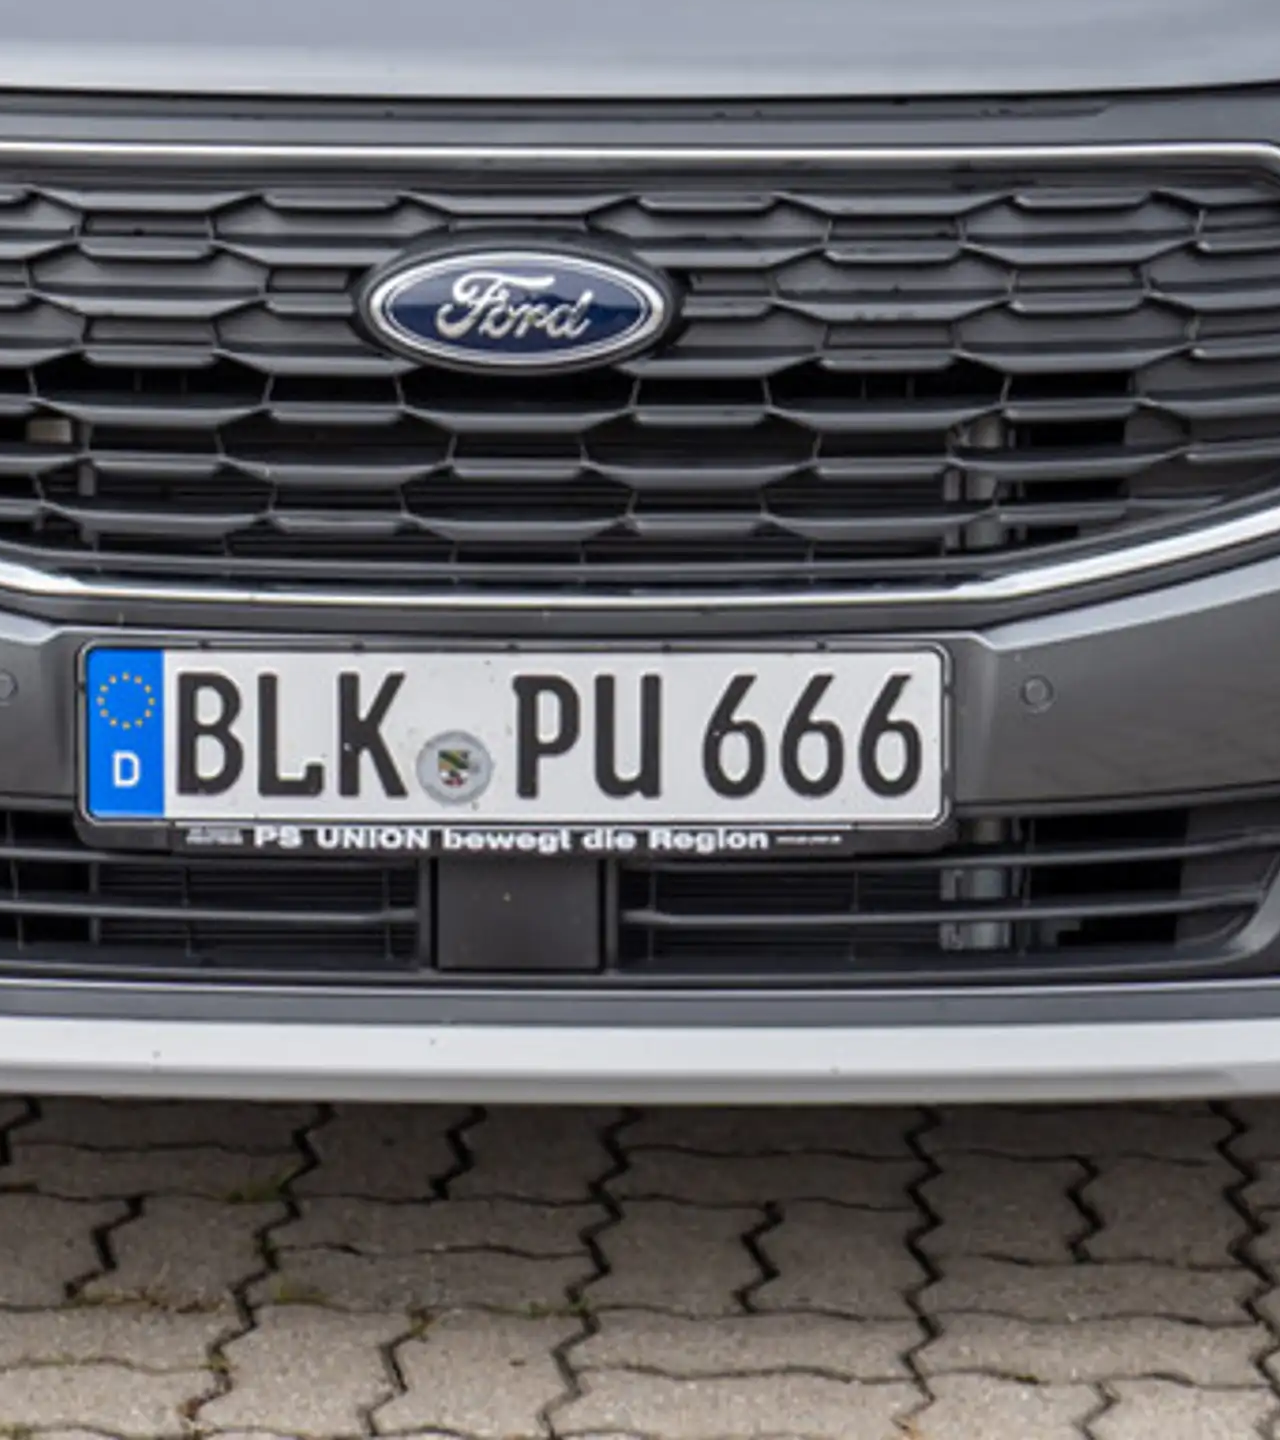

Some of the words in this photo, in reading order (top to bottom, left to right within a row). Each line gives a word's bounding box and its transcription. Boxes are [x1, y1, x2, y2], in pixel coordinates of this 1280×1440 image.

[435, 271, 595, 340] Ford
[176, 672, 409, 799] BLK
[512, 673, 662, 799] PU
[701, 673, 922, 799] 666
[112, 750, 141, 788] D
[253, 827, 303, 849] PS
[317, 827, 430, 850] UNION
[441, 826, 572, 855] bewegt
[582, 826, 637, 851] die
[648, 827, 770, 855] Region
